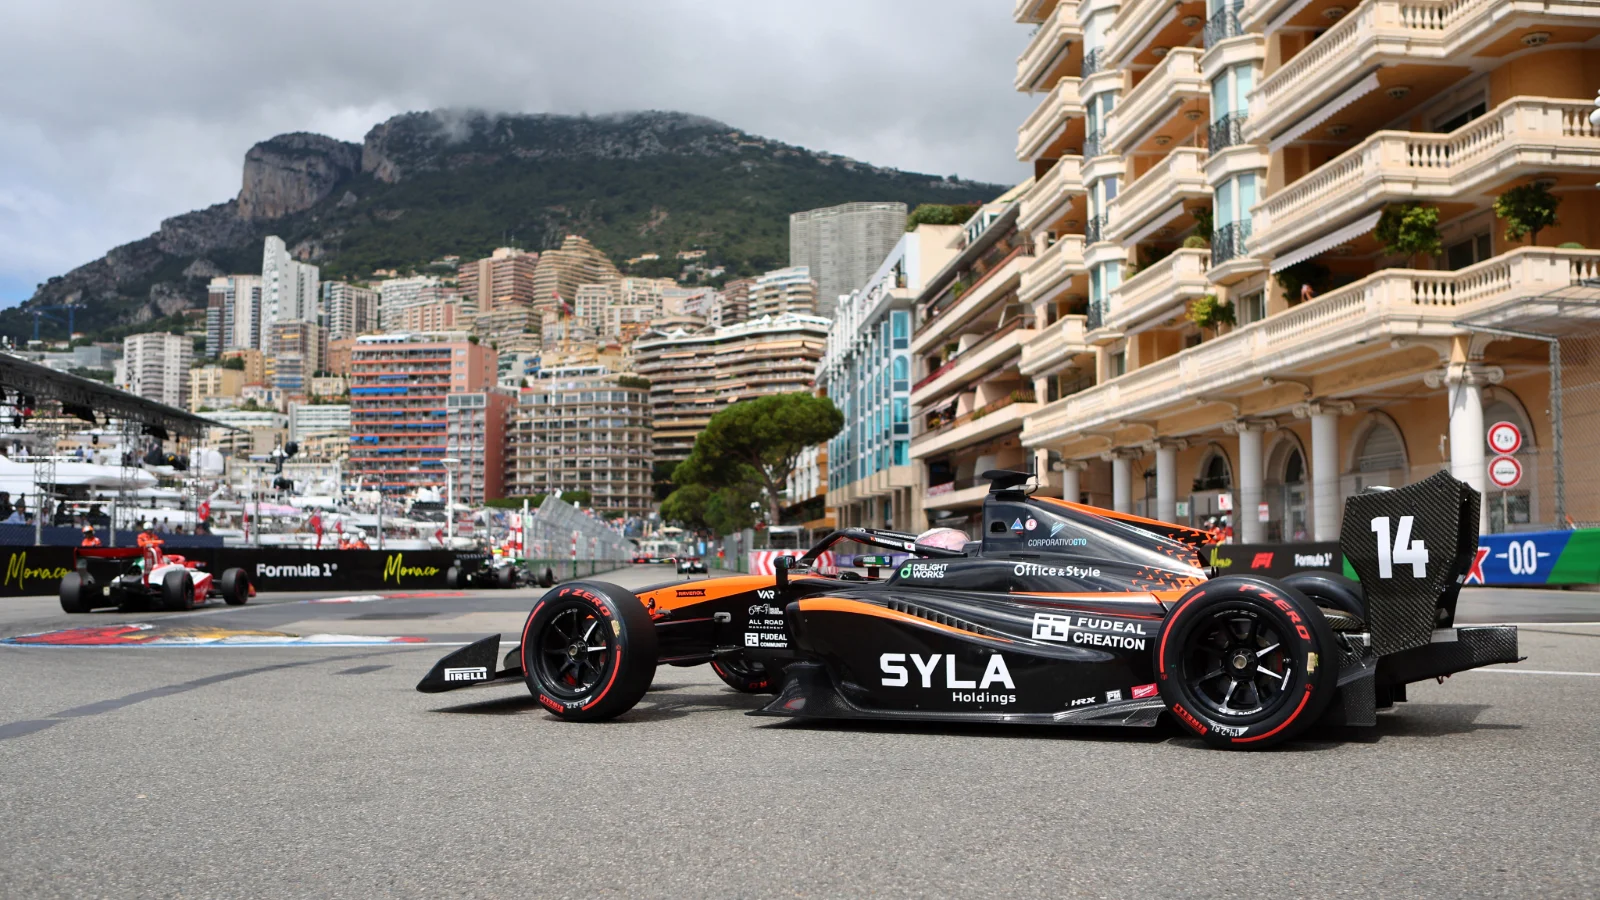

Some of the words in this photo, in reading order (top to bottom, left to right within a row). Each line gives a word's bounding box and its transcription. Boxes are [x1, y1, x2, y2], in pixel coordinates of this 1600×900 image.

[1371, 516, 1429, 579] 14
[1294, 553, 1324, 567] Formula
[1508, 540, 1538, 575] 0.0
[4, 551, 72, 590] Monaco
[256, 563, 320, 577] Formula
[384, 553, 440, 585] Monaco
[559, 588, 570, 597] P
[572, 588, 611, 617] ZERO
[757, 590, 775, 599] VAR
[1238, 584, 1258, 592] P
[1258, 591, 1311, 640] ZERO
[1077, 617, 1146, 635] FUDEAL
[760, 633, 787, 641] FUDEAL
[1073, 631, 1145, 650] CREATION
[444, 667, 487, 681] PIRELLI
[880, 653, 1016, 689] SYLA
[540, 694, 564, 713] PIRELLI
[952, 692, 1016, 705] Holdings
[1071, 696, 1096, 706] HRX
[1173, 703, 1208, 736] PIRELLI
